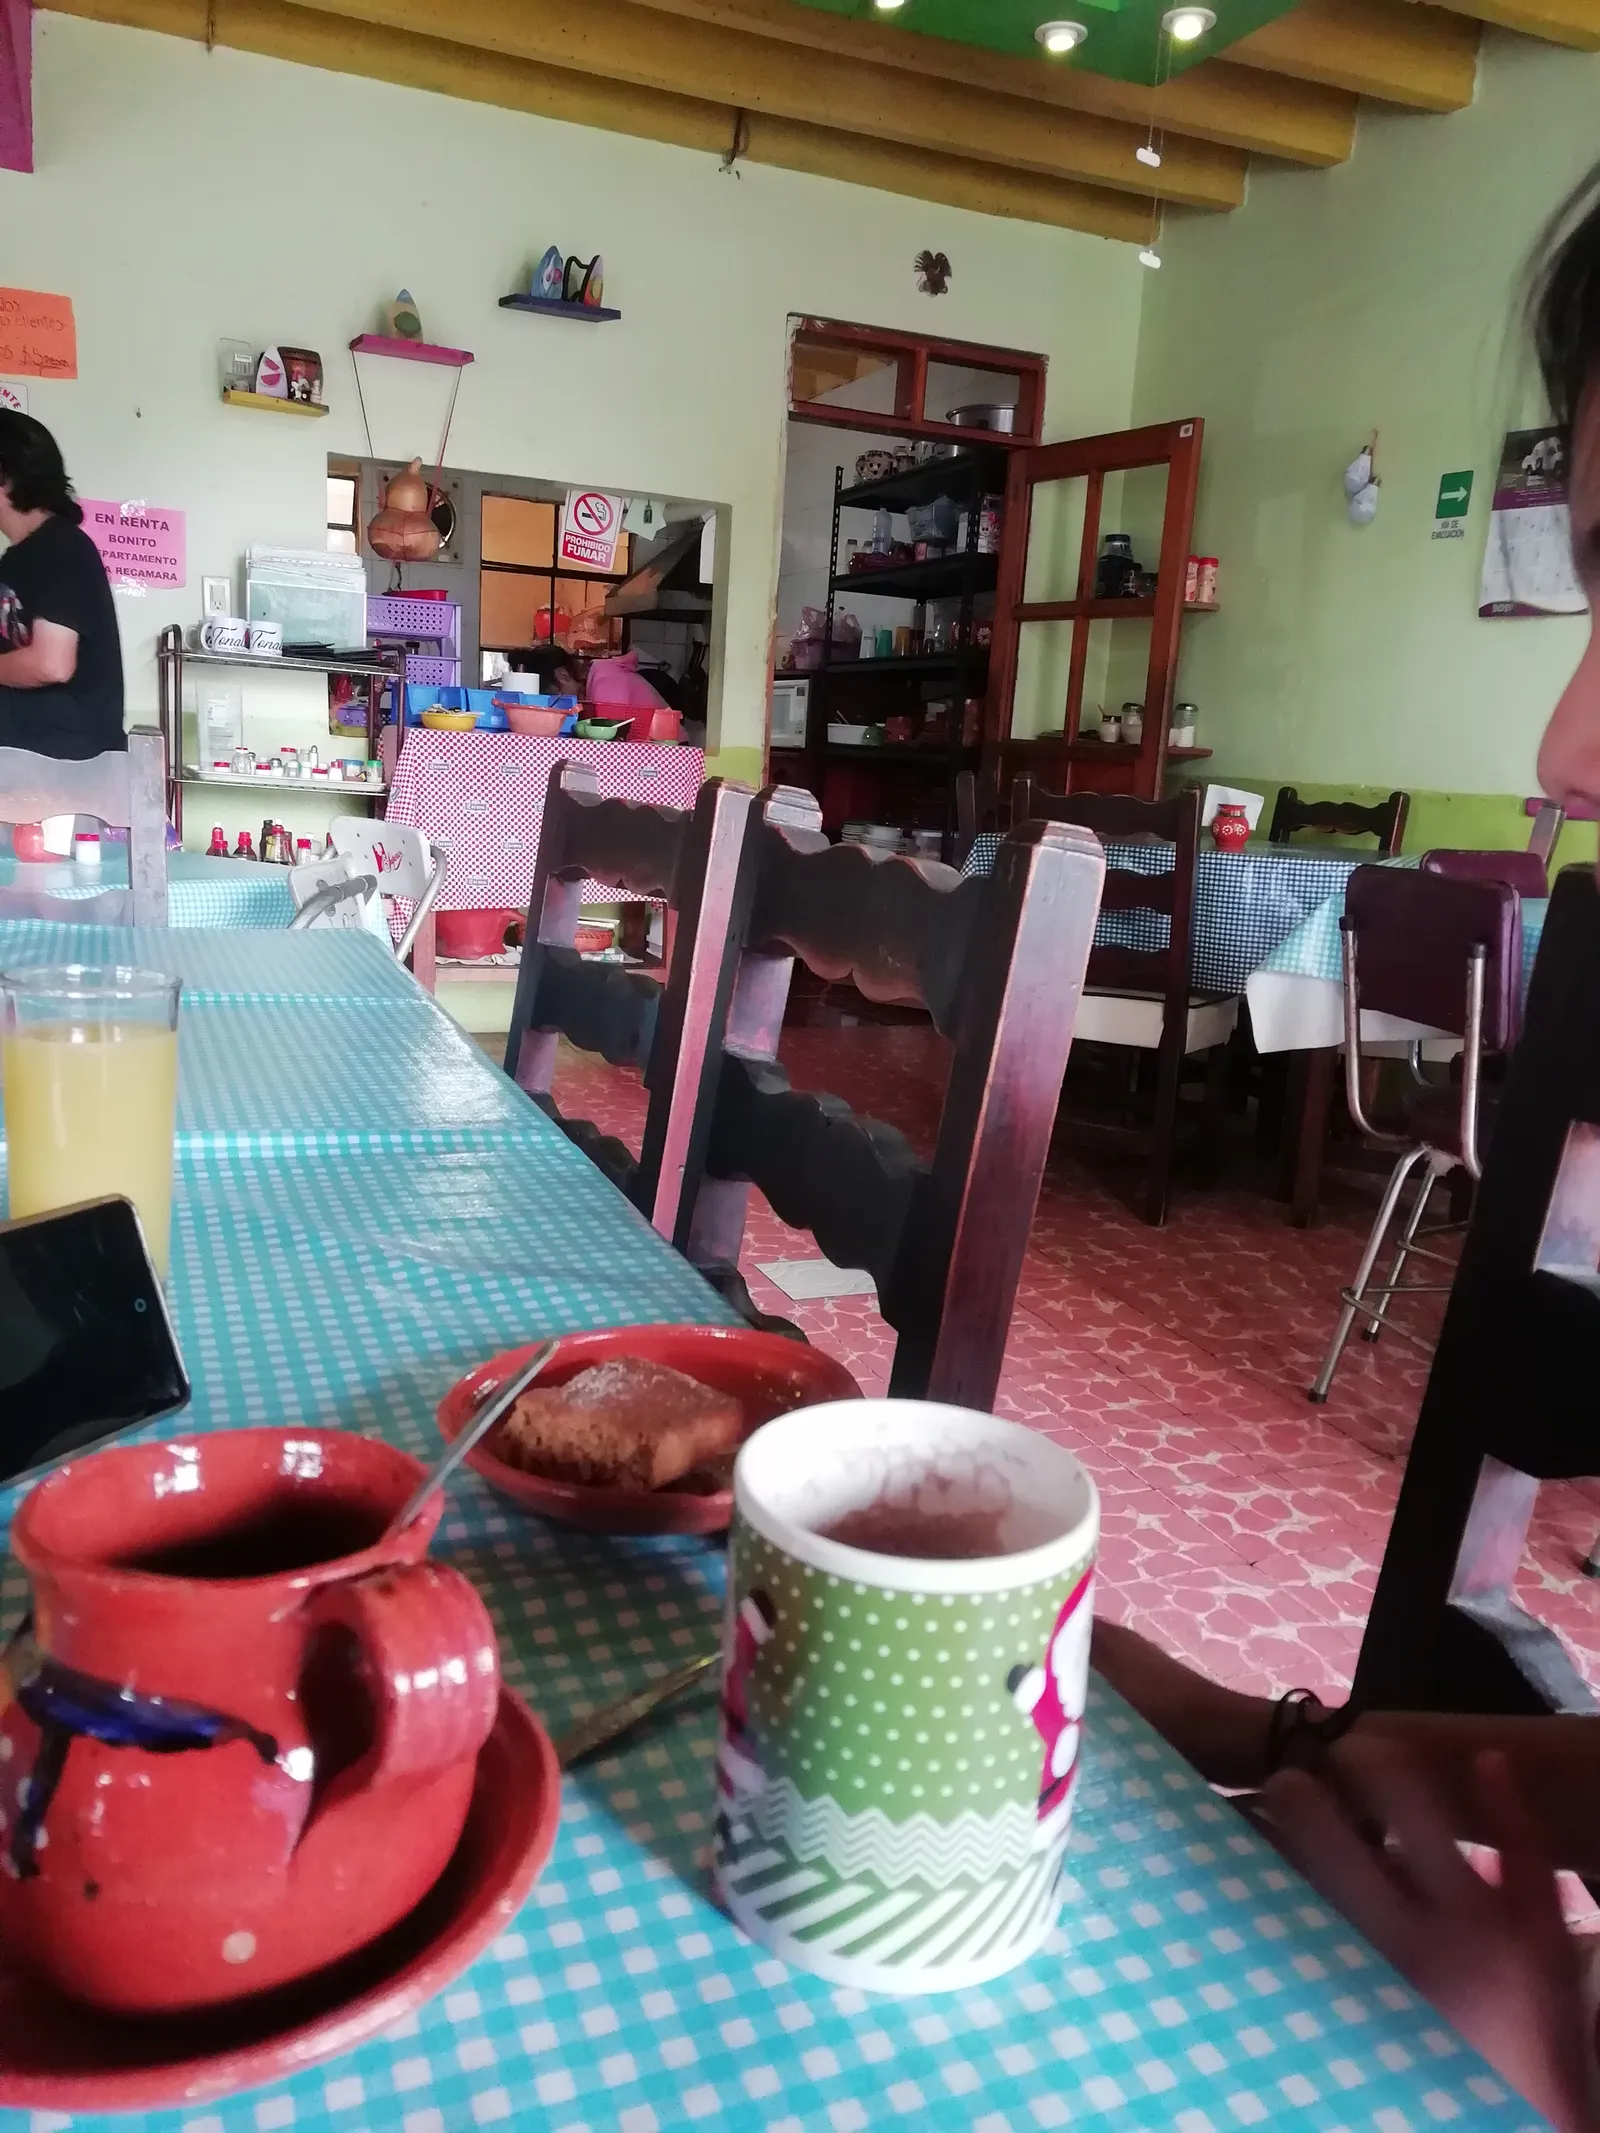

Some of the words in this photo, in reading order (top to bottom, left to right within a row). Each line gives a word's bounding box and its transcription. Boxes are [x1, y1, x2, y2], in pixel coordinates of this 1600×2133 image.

[94, 513, 115, 525] EN
[120, 516, 170, 532] RENTA
[108, 533, 157, 548] BONITO
[565, 534, 611, 553] PROHIBIDO
[98, 550, 178, 566] PARTAMENTO
[567, 543, 607, 563] FUMAR
[116, 567, 178, 581] RECAMARA
